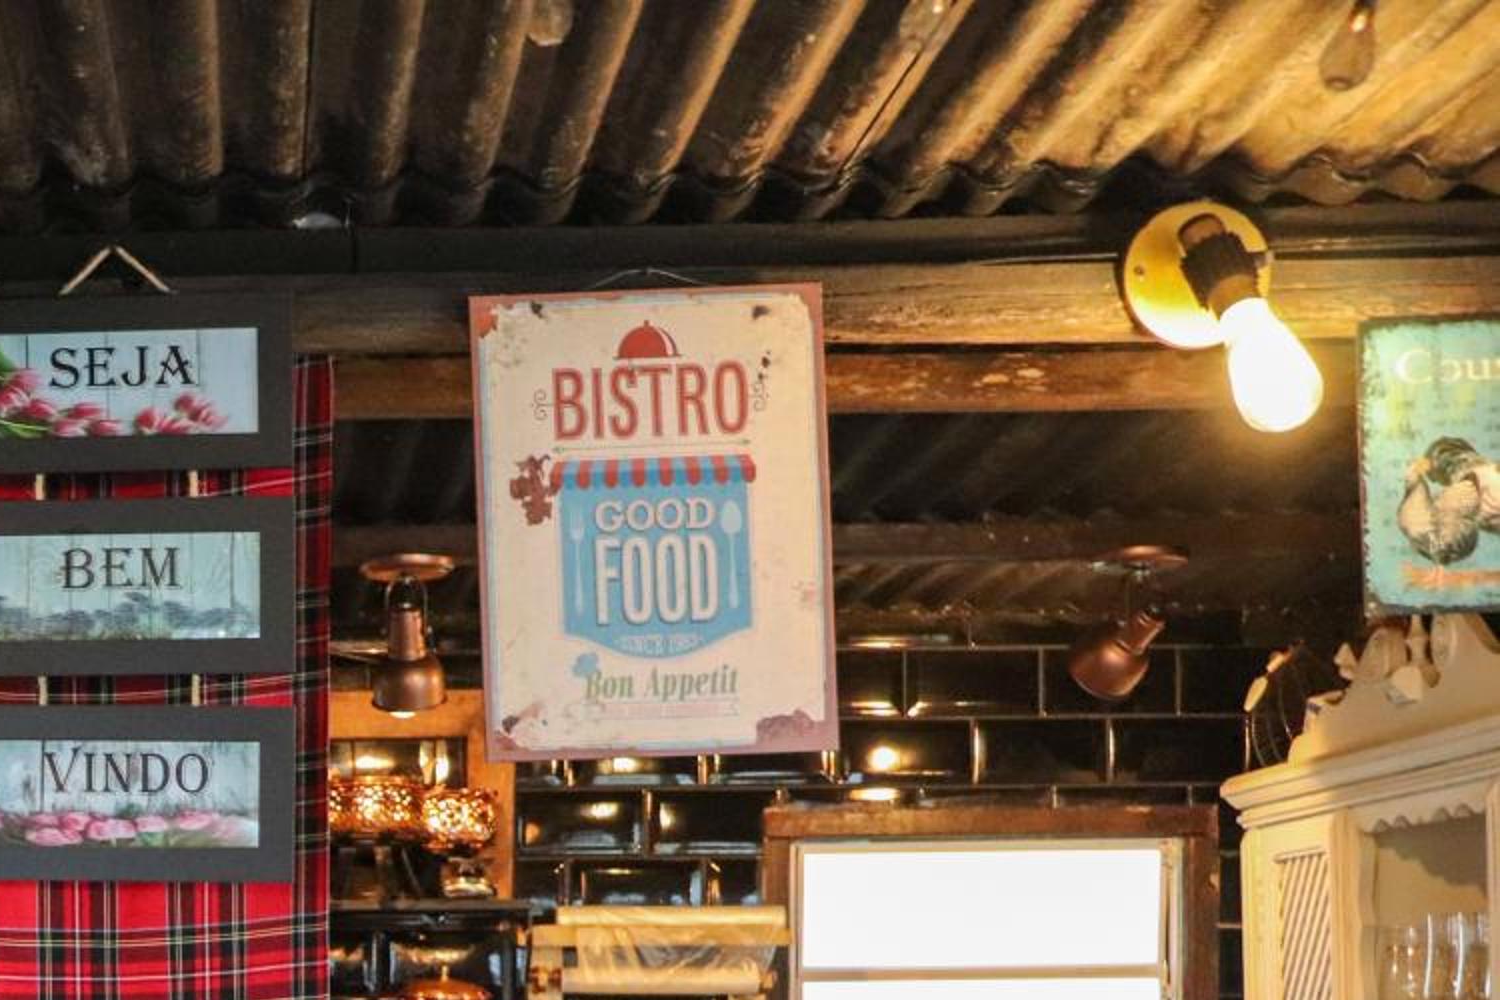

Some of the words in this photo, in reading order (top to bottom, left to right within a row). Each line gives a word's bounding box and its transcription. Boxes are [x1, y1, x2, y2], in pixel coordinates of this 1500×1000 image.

[49, 345, 194, 389] SEJA
[1393, 348, 1500, 384] Cou
[551, 359, 749, 441] BISTRO
[594, 497, 717, 533] GOOD
[60, 547, 182, 590] BEM
[595, 533, 720, 626] FOOD
[584, 669, 634, 701] Bon
[644, 663, 739, 702] Appetit
[43, 745, 210, 794] VINDO
